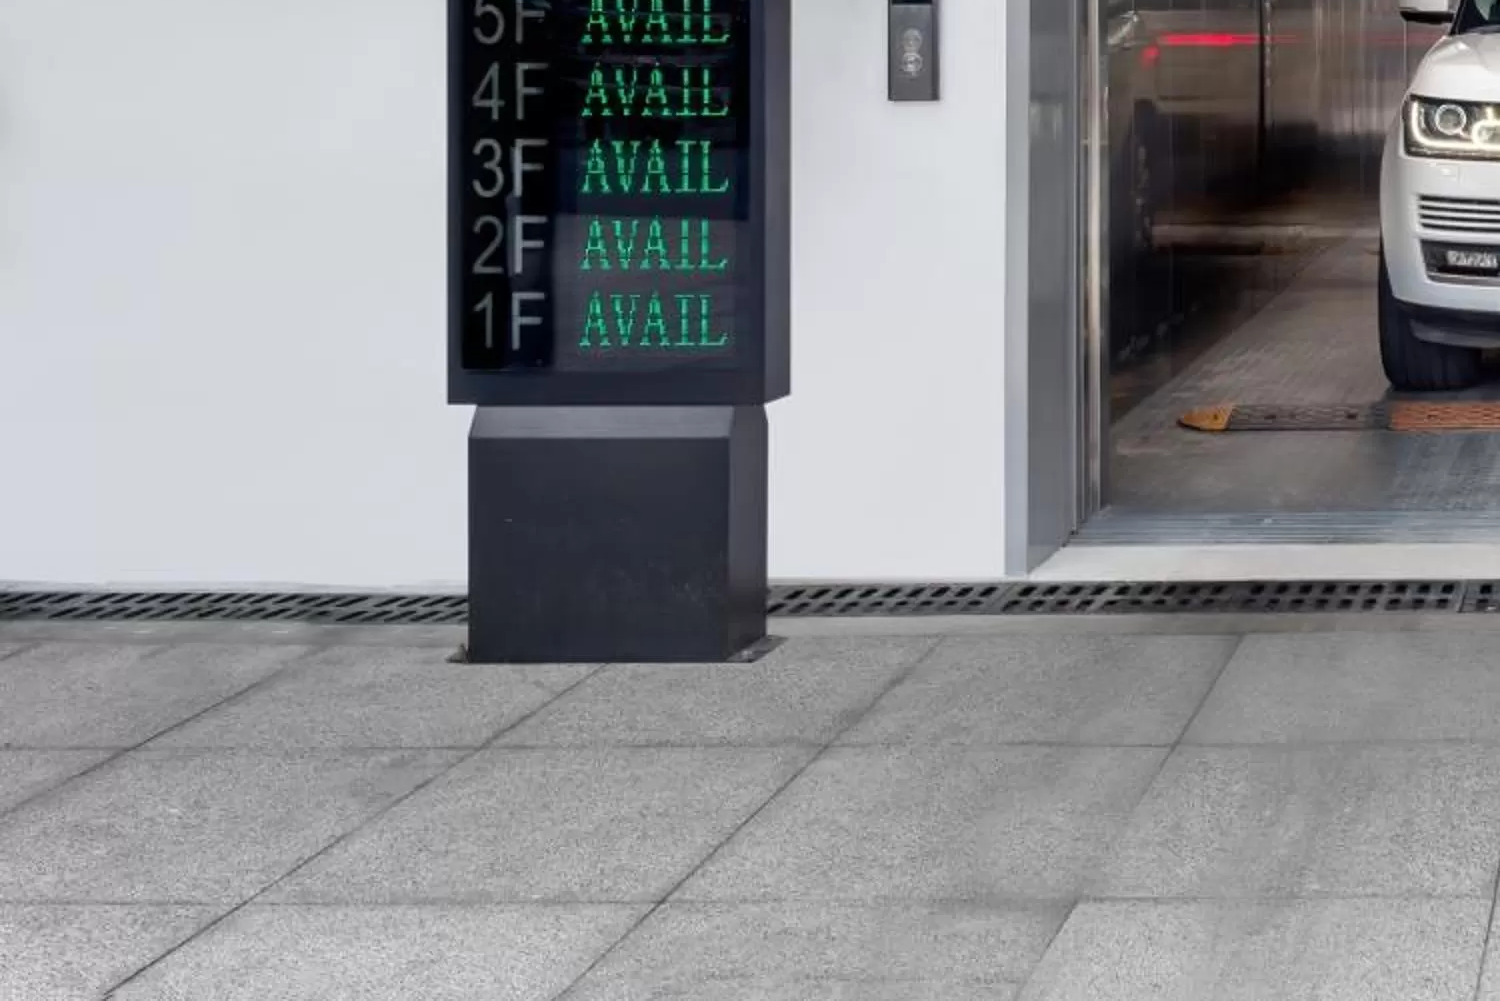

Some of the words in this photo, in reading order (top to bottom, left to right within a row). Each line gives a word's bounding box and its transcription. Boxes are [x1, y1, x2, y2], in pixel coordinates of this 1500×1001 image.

[472, 62, 549, 120] 4F
[581, 61, 729, 117] AVAIL
[472, 138, 549, 198] 3F
[581, 138, 729, 194] AVAIL
[472, 215, 547, 274] 2F
[580, 215, 728, 270] AVAIL
[473, 292, 546, 351] 1F
[579, 291, 729, 346] AVAIL
